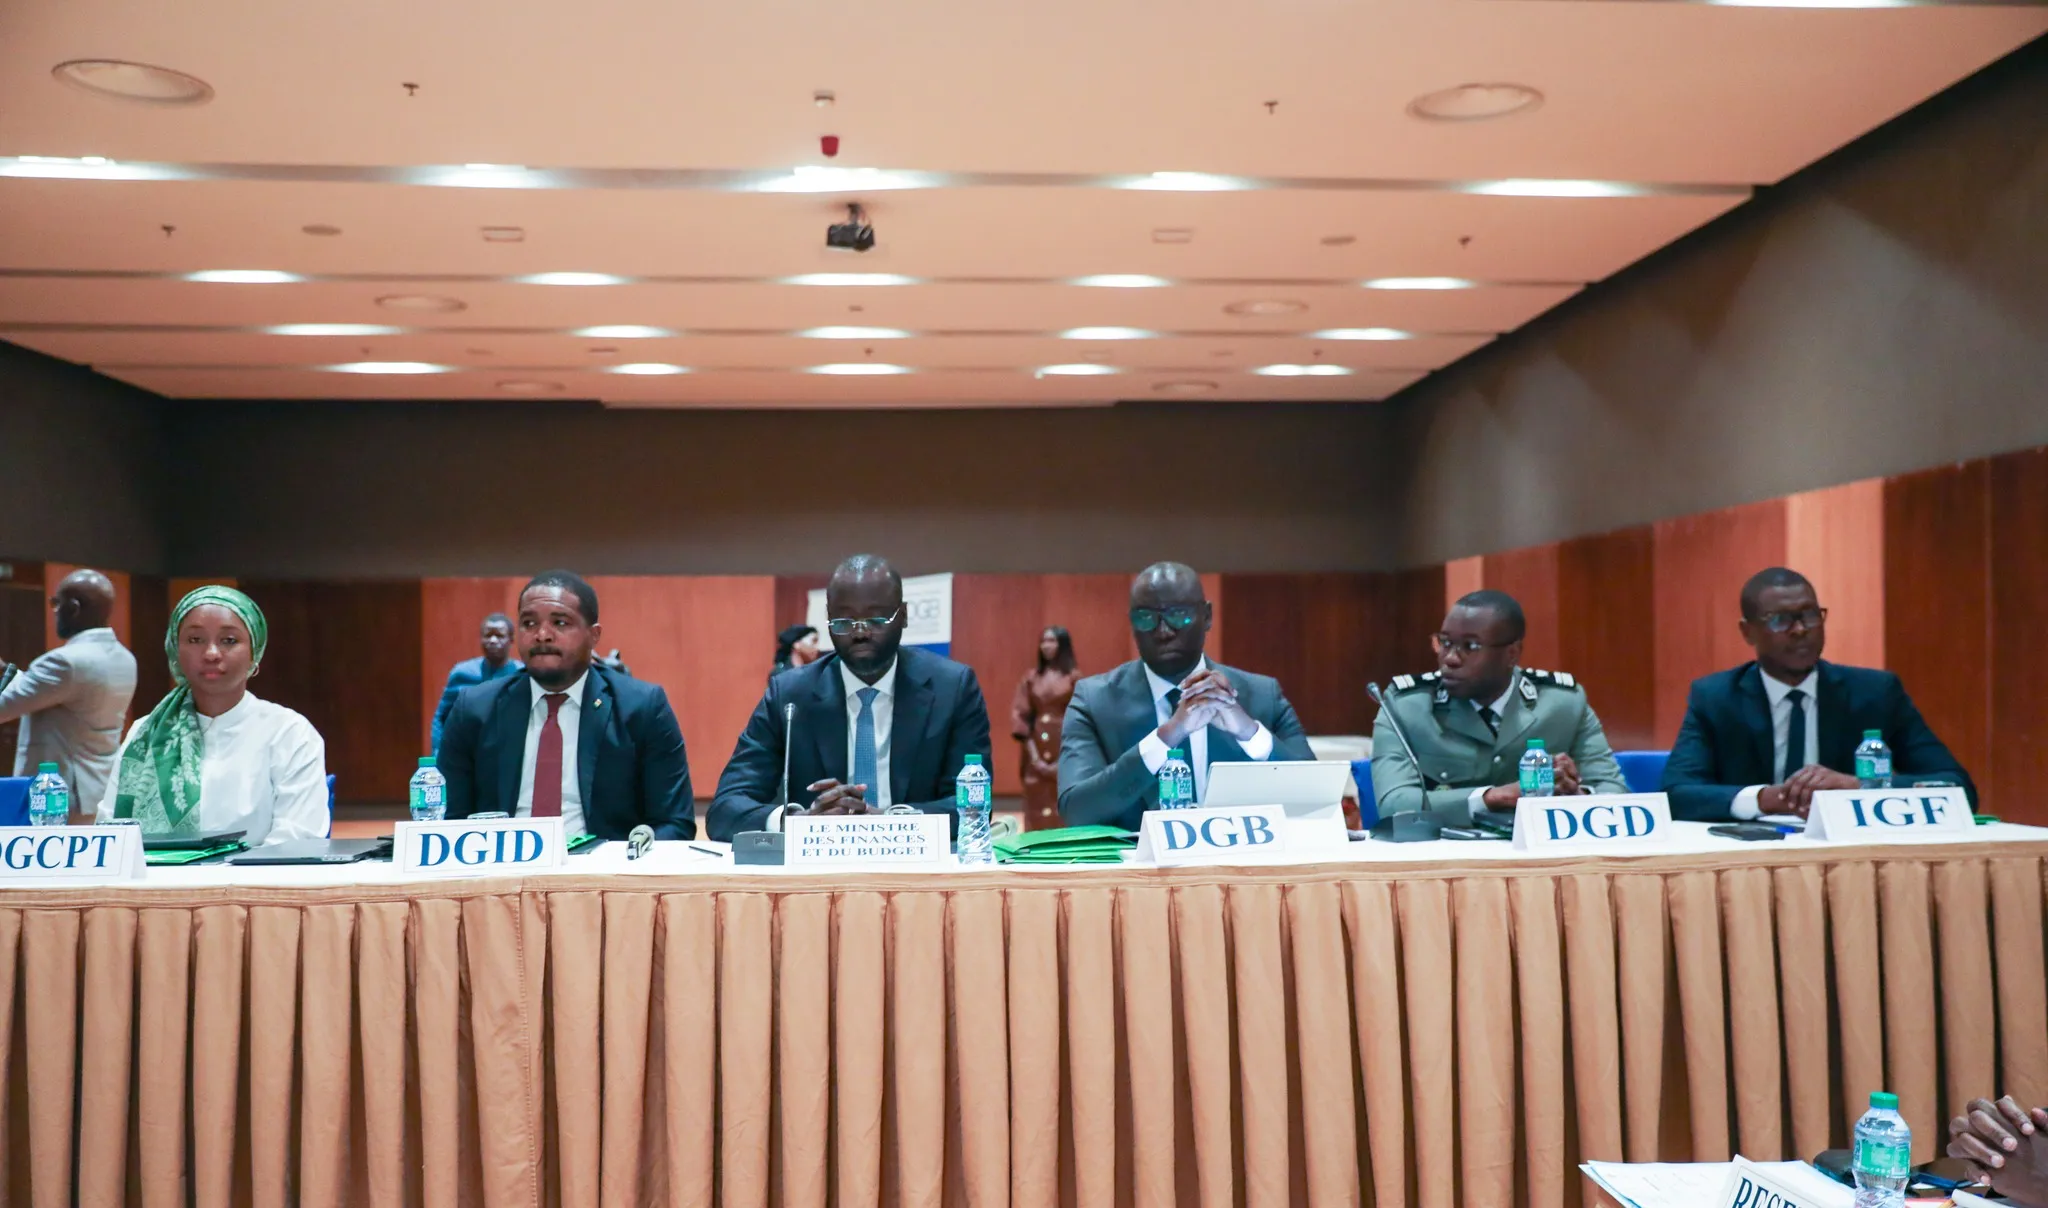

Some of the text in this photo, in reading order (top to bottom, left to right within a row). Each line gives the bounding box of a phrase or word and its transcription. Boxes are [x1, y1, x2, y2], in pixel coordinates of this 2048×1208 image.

[809, 822, 921, 833] LE MINISTRE
[1543, 805, 1655, 840] DGD
[1848, 796, 1948, 827] IGF
[416, 829, 544, 867] DGID
[803, 834, 926, 845] DES FINANCES
[1161, 815, 1275, 850] DGB
[0, 835, 116, 870] GCPT
[801, 846, 927, 857] ET DU BUDGET
